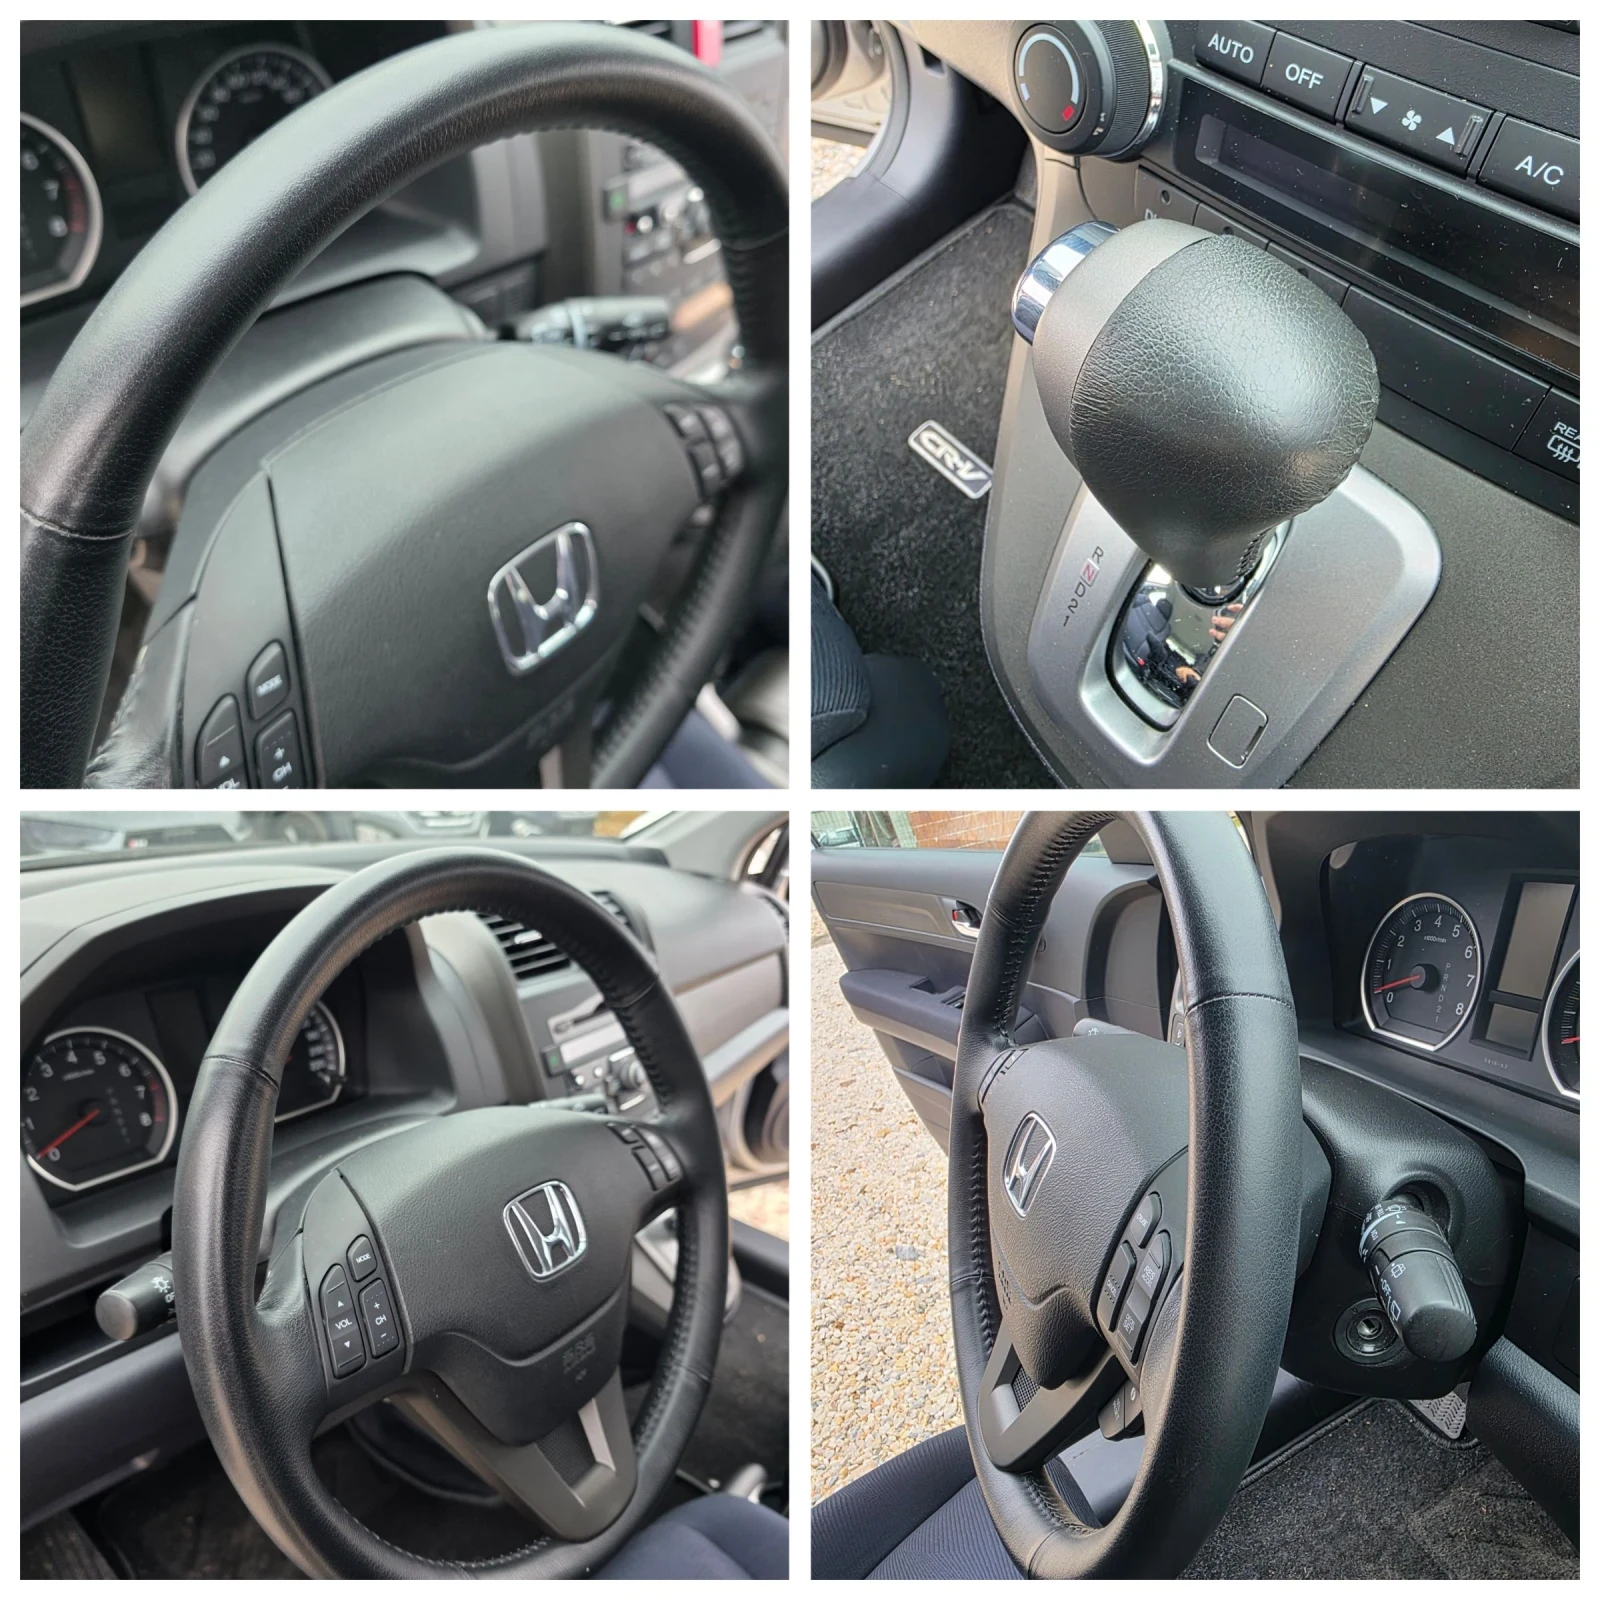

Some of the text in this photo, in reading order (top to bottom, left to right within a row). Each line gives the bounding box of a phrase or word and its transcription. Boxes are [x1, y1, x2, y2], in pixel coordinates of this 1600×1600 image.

[1207, 33, 1254, 63] AUTO
[1285, 63, 1324, 89] OFF
[1515, 155, 1564, 186] A/C
[1063, 546, 1104, 627] R N D 2 1
[1414, 919, 1422, 932] 3
[1434, 915, 1442, 928] 4
[1452, 924, 1461, 938] 5
[1397, 935, 1405, 947] 2
[1464, 945, 1473, 959] 6
[1387, 959, 1392, 970] 1
[1467, 974, 1475, 987] 7
[1387, 992, 1394, 1003] 0
[1456, 1002, 1464, 1015] 8
[66, 1050, 78, 1064] 4
[93, 1050, 106, 1066] 5
[40, 1063, 54, 1078] 3
[118, 1062, 132, 1077] 6
[26, 1087, 40, 1101] 2
[134, 1085, 146, 1099] 7
[139, 1112, 152, 1127] 8
[48, 1147, 61, 1162] 0
[355, 1252, 372, 1264] MODE
[1143, 1265, 1156, 1280] RES
[335, 1317, 353, 1330] VOL
[375, 1314, 387, 1326] CH
